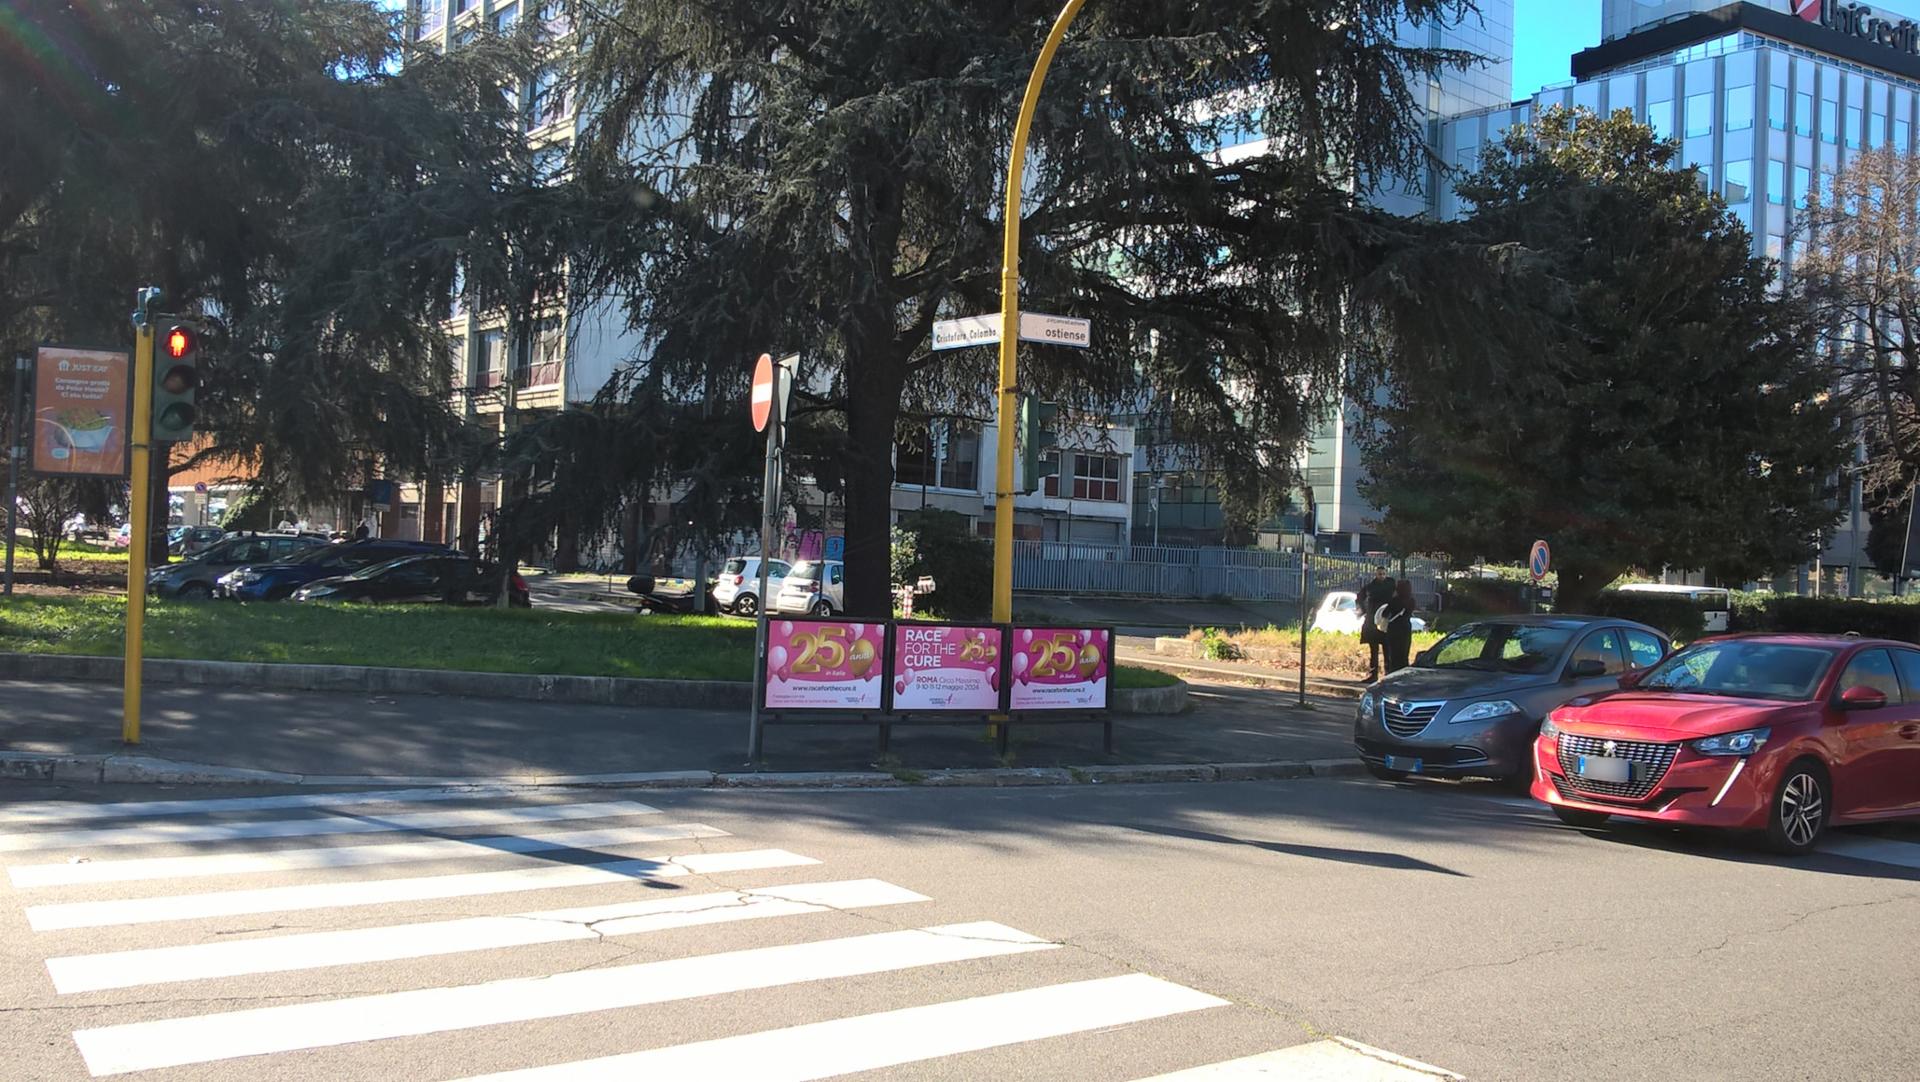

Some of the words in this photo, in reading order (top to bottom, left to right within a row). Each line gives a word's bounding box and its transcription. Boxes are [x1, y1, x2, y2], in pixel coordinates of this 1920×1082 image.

[936, 331, 967, 344] Cristoforo
[969, 327, 997, 340] Colombo
[1045, 328, 1086, 341] ostiense
[905, 629, 943, 642] RACE
[790, 626, 846, 673] 25
[904, 642, 931, 655] FOR
[933, 643, 956, 655] THE
[959, 638, 985, 661] 25
[1029, 632, 1077, 677] 25
[904, 654, 942, 667] CURE
